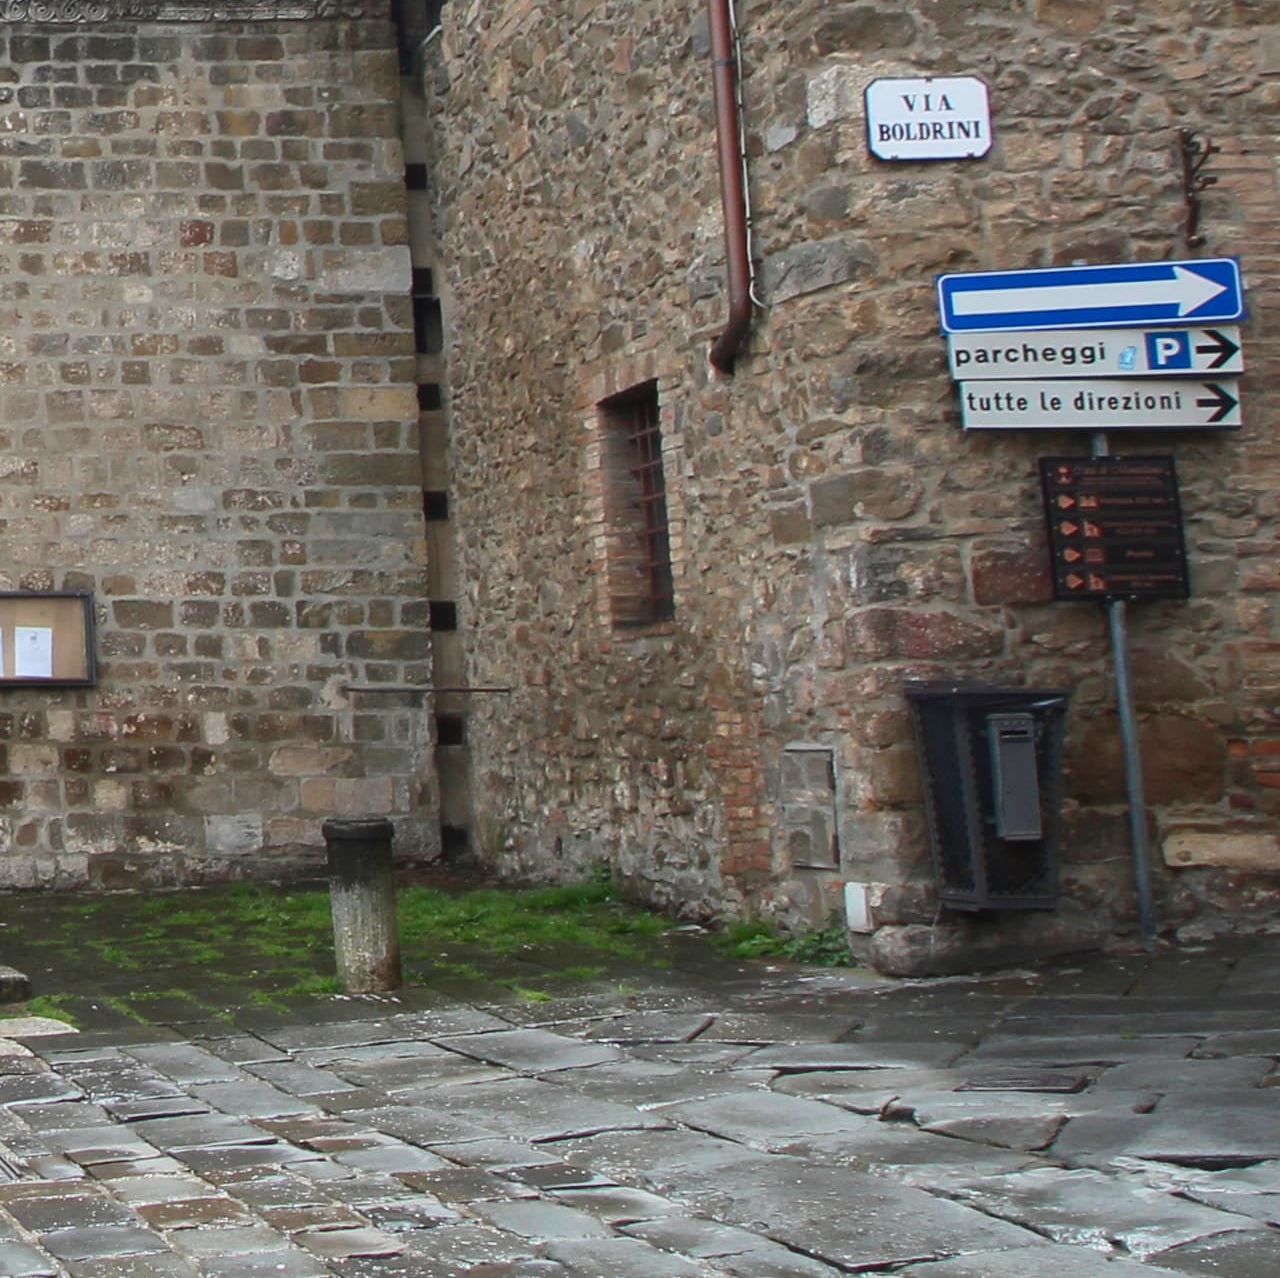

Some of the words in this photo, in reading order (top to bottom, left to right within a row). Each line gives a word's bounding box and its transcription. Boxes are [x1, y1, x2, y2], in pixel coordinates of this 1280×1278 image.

[901, 94, 954, 112] VIA
[878, 120, 982, 142] BOLDRINI
[954, 342, 1106, 367] parcheggi
[1155, 337, 1180, 365] P
[966, 392, 1029, 411] tutte
[1040, 391, 1062, 411] le
[1073, 391, 1182, 412] direzioni
